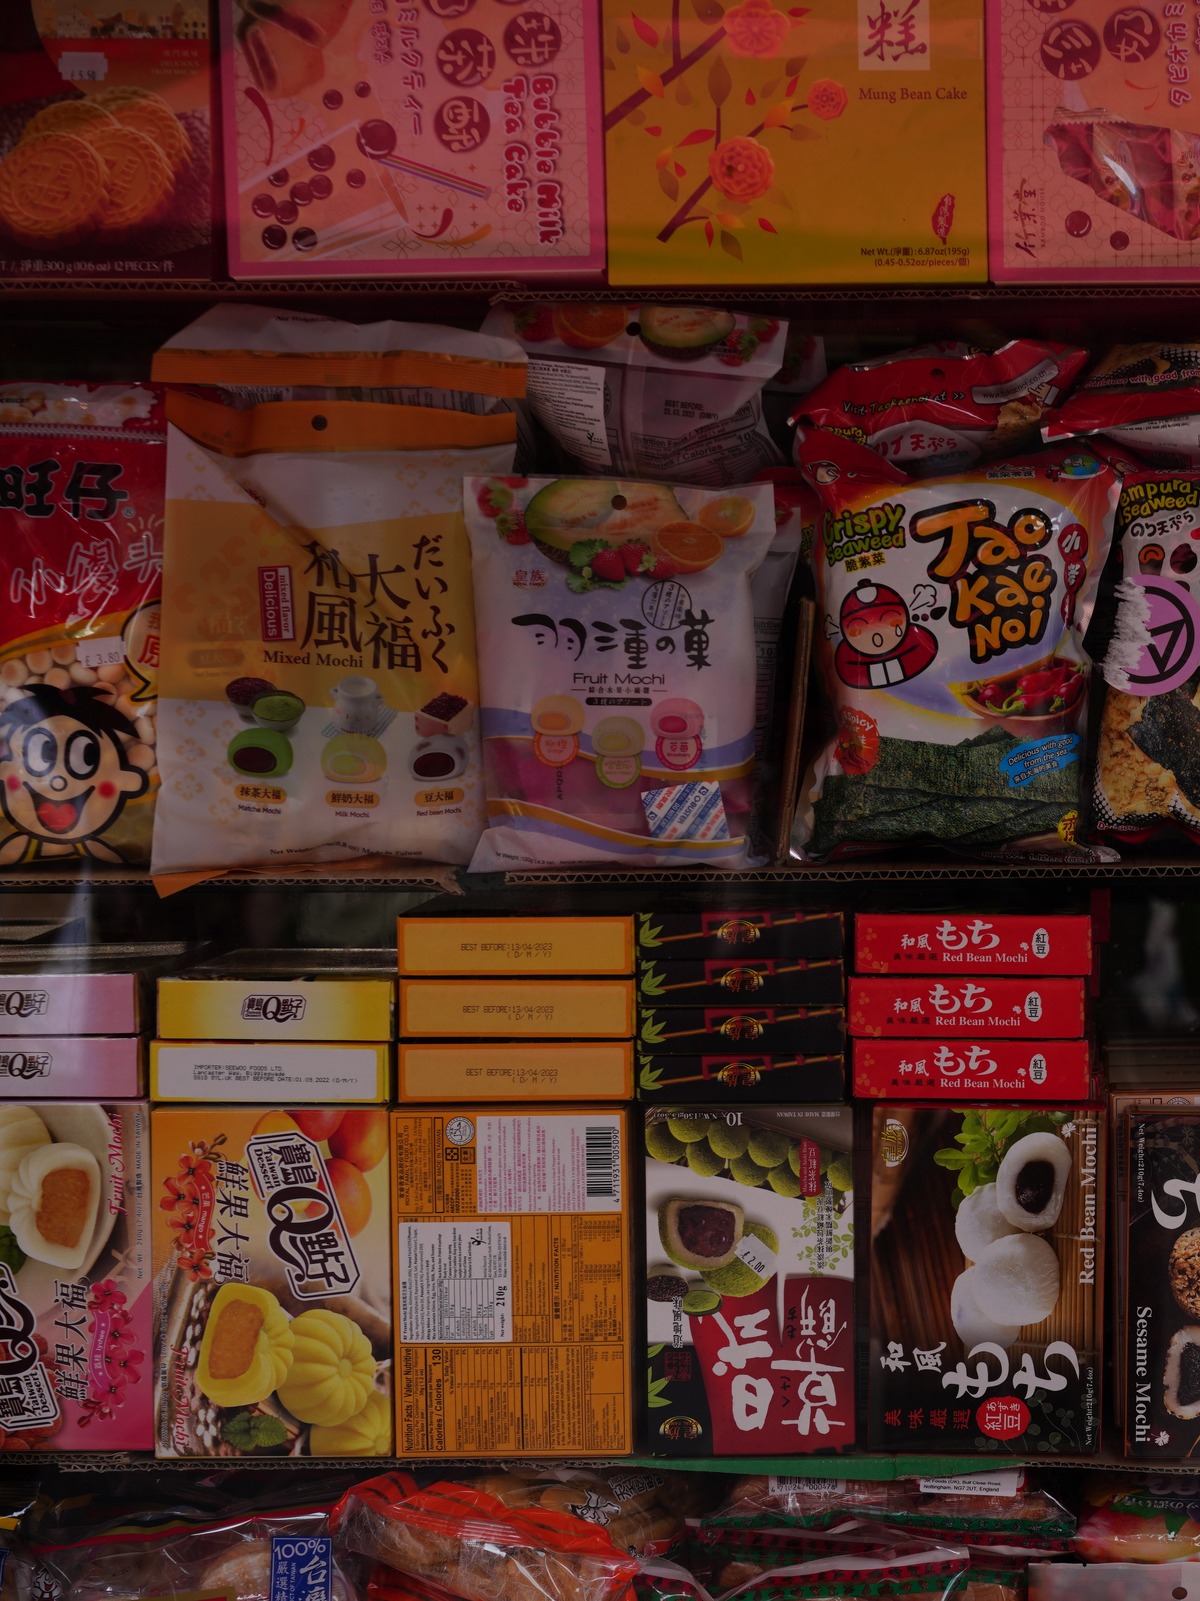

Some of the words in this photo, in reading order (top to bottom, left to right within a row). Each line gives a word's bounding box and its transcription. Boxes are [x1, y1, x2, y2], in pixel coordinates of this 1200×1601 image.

[502, 76, 528, 135] Tea
[859, 88, 896, 103] Mung
[900, 88, 931, 100] Bean
[935, 88, 967, 100] Cake
[531, 75, 559, 174] Bubble
[503, 143, 529, 213] Cake
[536, 182, 563, 245] Milk
[0, 458, 129, 521] 旺仔
[822, 503, 905, 546] Crispy
[911, 500, 1052, 582] Tao
[1131, 512, 1193, 537] のり天ぷら
[514, 570, 545, 582] 皇族
[845, 552, 886, 572] 脆紫菜
[263, 571, 279, 637] Delicious
[413, 534, 455, 674] だいふく
[952, 556, 1054, 622] Kae
[351, 554, 422, 672] 大福
[263, 650, 310, 665] Mixed
[316, 653, 364, 668] Mochi
[573, 673, 608, 685] Fruit
[614, 673, 665, 685] Mochi
[335, 810, 348, 818] Milk
[942, 953, 963, 962] Red
[966, 953, 992, 962] Bean
[995, 953, 1028, 963] Mochi
[1035, 932, 1046, 954] 紅豆
[462, 1005, 479, 1014] BEST
[484, 1005, 554, 1014] BEFORE:13/04/2023
[935, 1016, 956, 1026] Red
[959, 1016, 985, 1026] Bean
[988, 1017, 1021, 1026] Mochi
[1028, 996, 1039, 1018] 紅豆
[465, 1068, 483, 1077] BEST
[487, 1068, 558, 1077] BEFORE:13/04/2023
[940, 1078, 961, 1088] Red
[964, 1078, 989, 1088] Bean
[993, 1079, 1025, 1089] Mochi
[1033, 1059, 1044, 1080] 紅豆
[107, 1113, 124, 1173] Mochi
[1081, 1127, 1098, 1193] Mochi
[254, 1148, 275, 1191] Dessert
[109, 1174, 129, 1217] Fruit
[215, 1160, 250, 1287] 鮮果大福
[1081, 1197, 1096, 1245] Bean
[1080, 1251, 1096, 1285] Red
[54, 1277, 89, 1401] 鮮果大福
[1135, 1306, 1152, 1376] Sesame
[171, 1345, 190, 1387] Fruit
[711, 1308, 774, 1431] 日式
[33, 1372, 50, 1413] Dessert
[780, 1376, 791, 1407] くさ
[1135, 1381, 1151, 1442] Mochi
[172, 1389, 191, 1449] Mochi
[884, 1408, 971, 1430] 美味嚴選
[985, 1412, 1022, 1432] 紅豆
[274, 1539, 326, 1560] 100%
